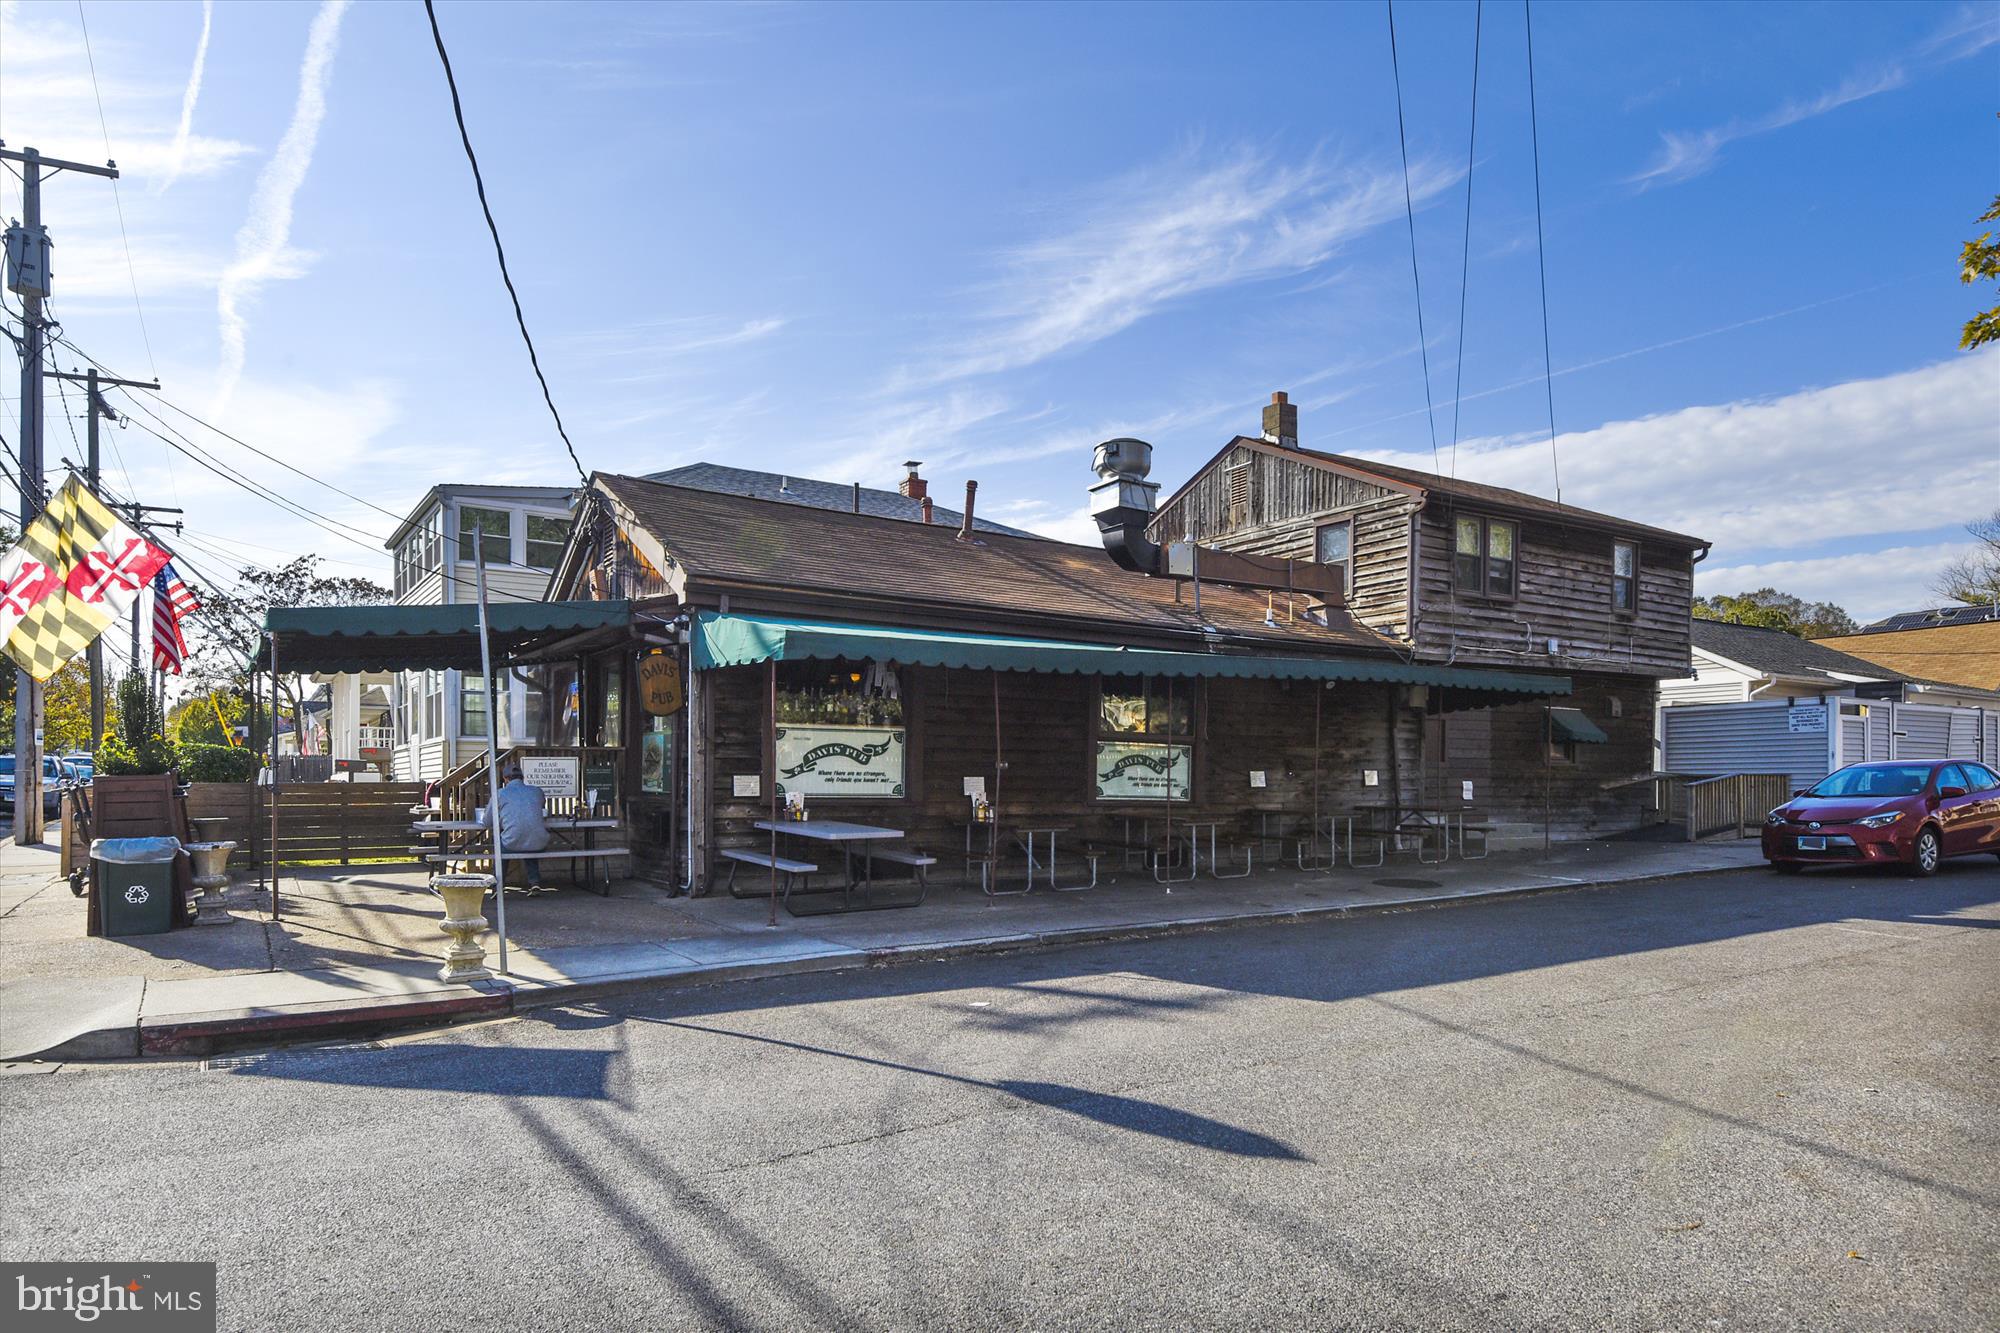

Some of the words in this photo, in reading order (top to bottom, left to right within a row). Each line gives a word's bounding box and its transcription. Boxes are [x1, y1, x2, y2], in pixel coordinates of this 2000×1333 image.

[651, 691, 674, 705] PUB
[846, 747, 868, 762] PUB
[1146, 758, 1163, 772] PUB
